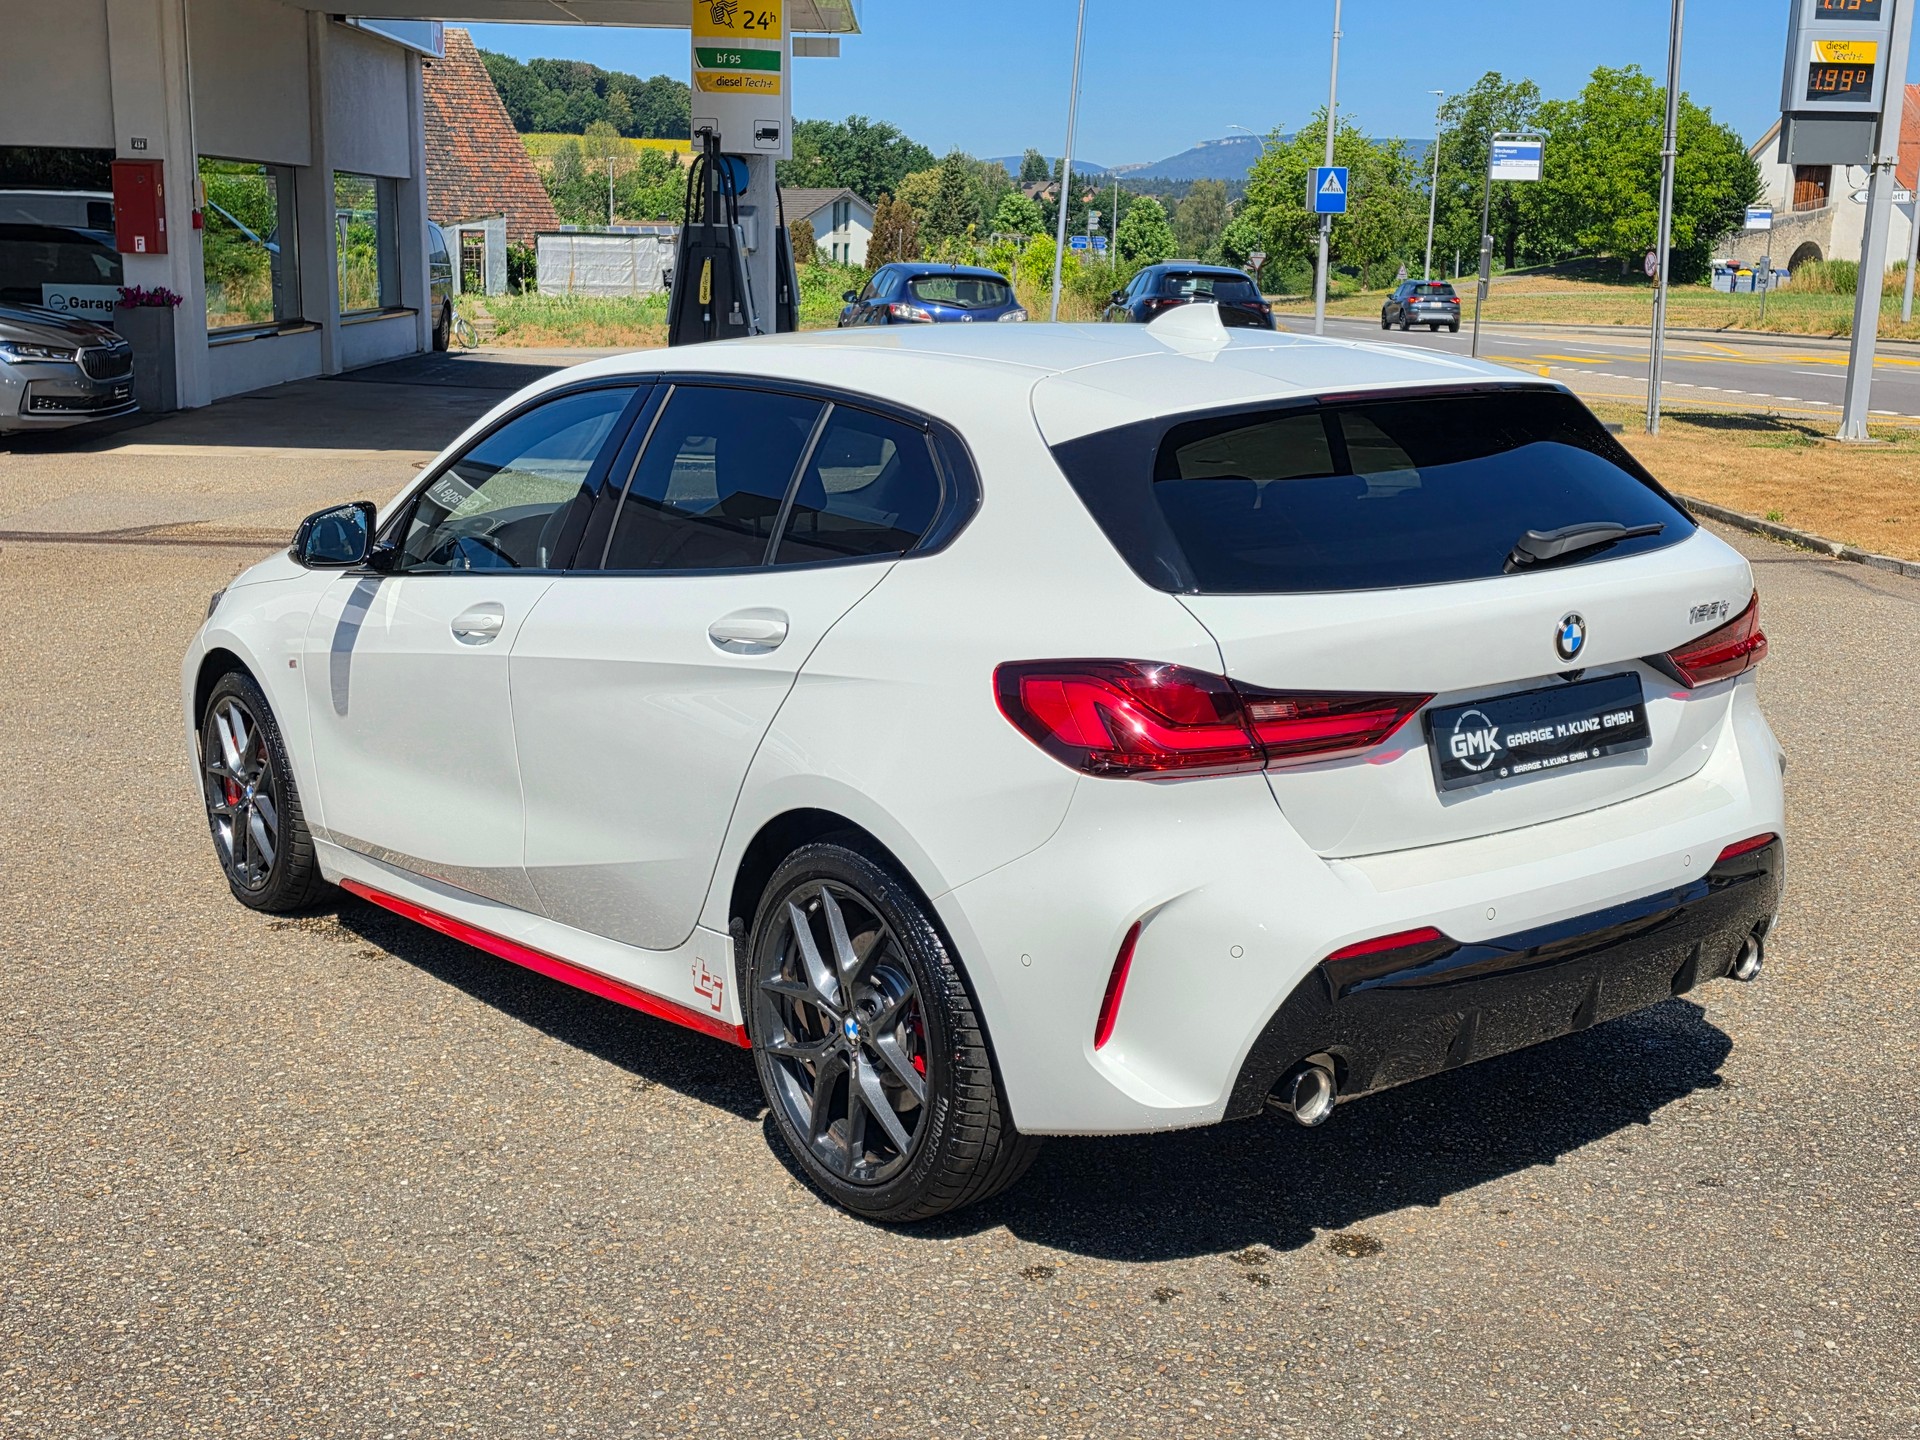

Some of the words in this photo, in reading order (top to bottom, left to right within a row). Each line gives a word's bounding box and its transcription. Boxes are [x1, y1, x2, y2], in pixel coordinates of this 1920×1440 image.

[743, 10, 777, 31] 24h
[1826, 41, 1850, 51] diesel
[716, 53, 728, 64] bf
[729, 54, 742, 64] 95
[716, 76, 743, 87] diesel
[744, 77, 774, 88] Tech+
[136, 239, 143, 250] F
[1506, 727, 1555, 748] GARAGE
[1556, 717, 1601, 738] M.KUNZ
[1603, 710, 1635, 728] GMBH
[1450, 726, 1502, 759] GMK
[1513, 761, 1542, 774] GARAGE
[1543, 755, 1569, 768] M.KUNZ
[1569, 751, 1589, 762] GMBH
